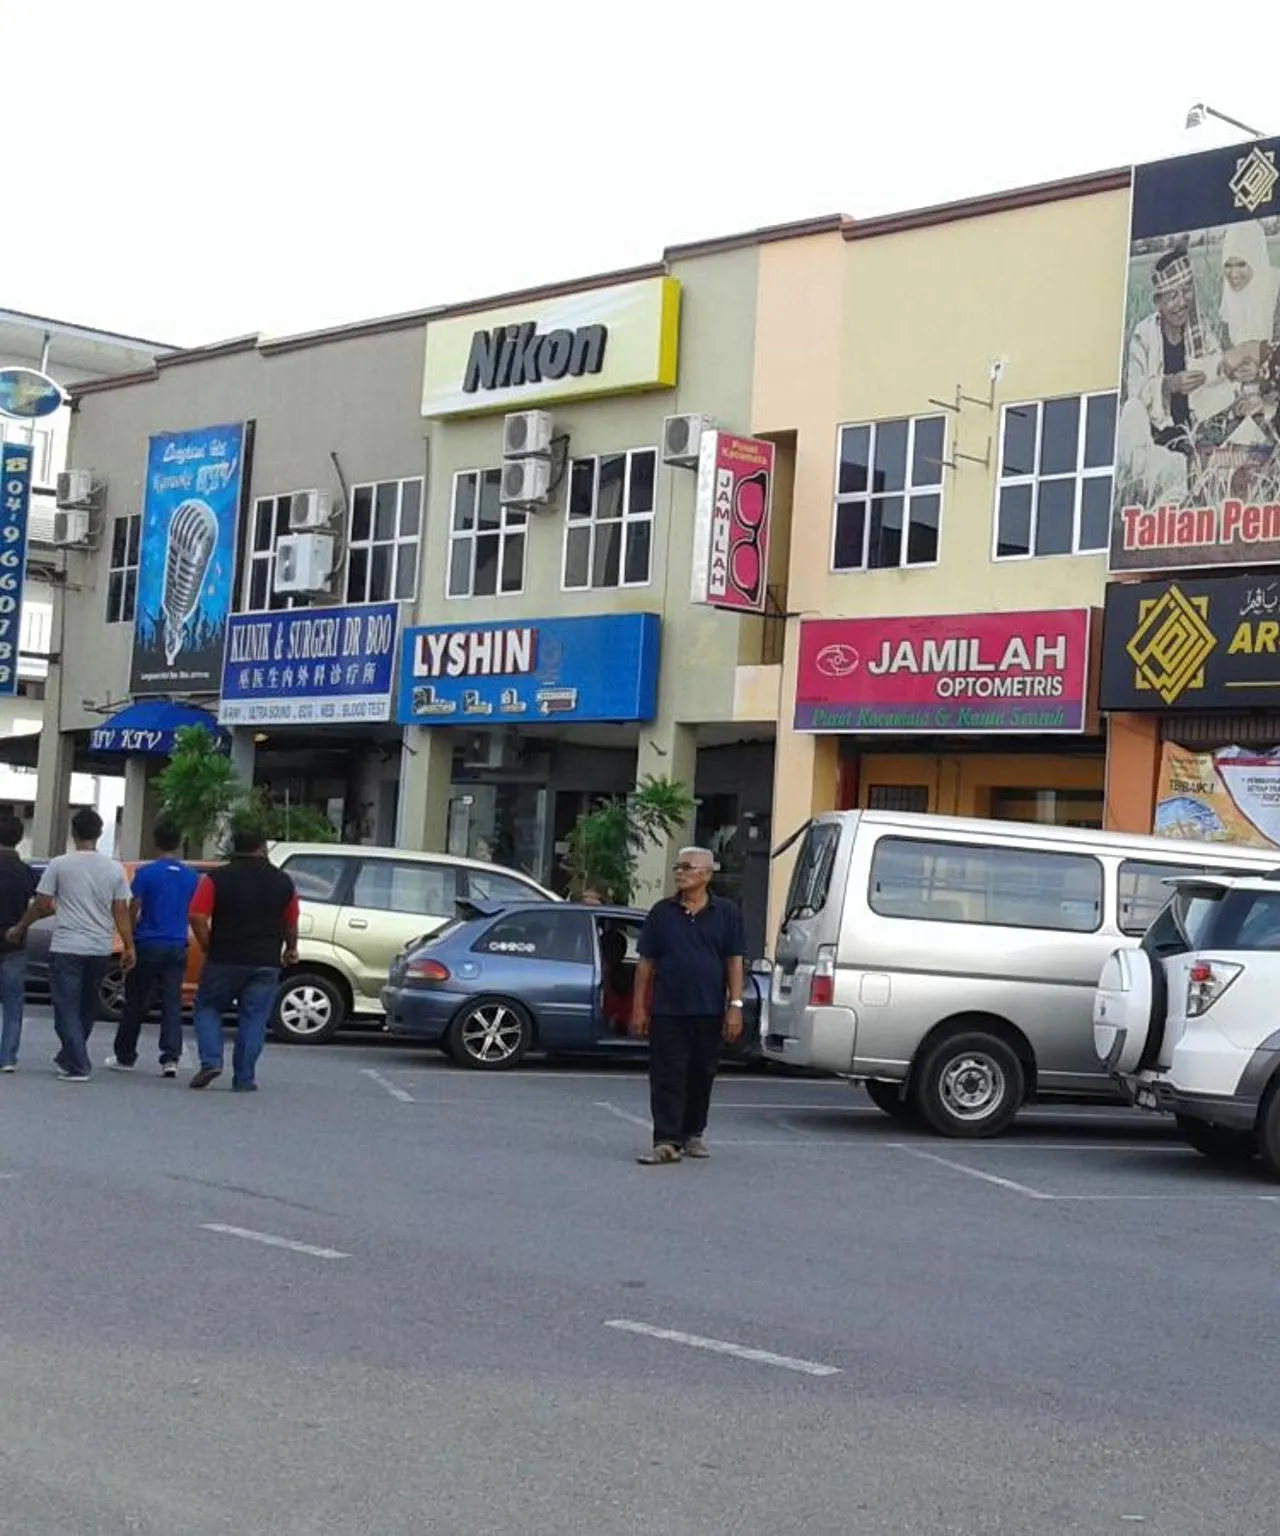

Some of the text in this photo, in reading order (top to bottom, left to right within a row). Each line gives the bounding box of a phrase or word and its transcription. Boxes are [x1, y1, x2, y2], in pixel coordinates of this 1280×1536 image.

[462, 319, 608, 394] Nikon
[711, 475, 731, 587] JAMILAH
[1122, 507, 1215, 549] Talian
[230, 614, 392, 662] KLINIK & SURGERI DR BOO
[411, 627, 538, 678] LYSHIN
[867, 635, 1067, 674] JAMILAH
[936, 676, 1063, 698] OPTOMETRIS
